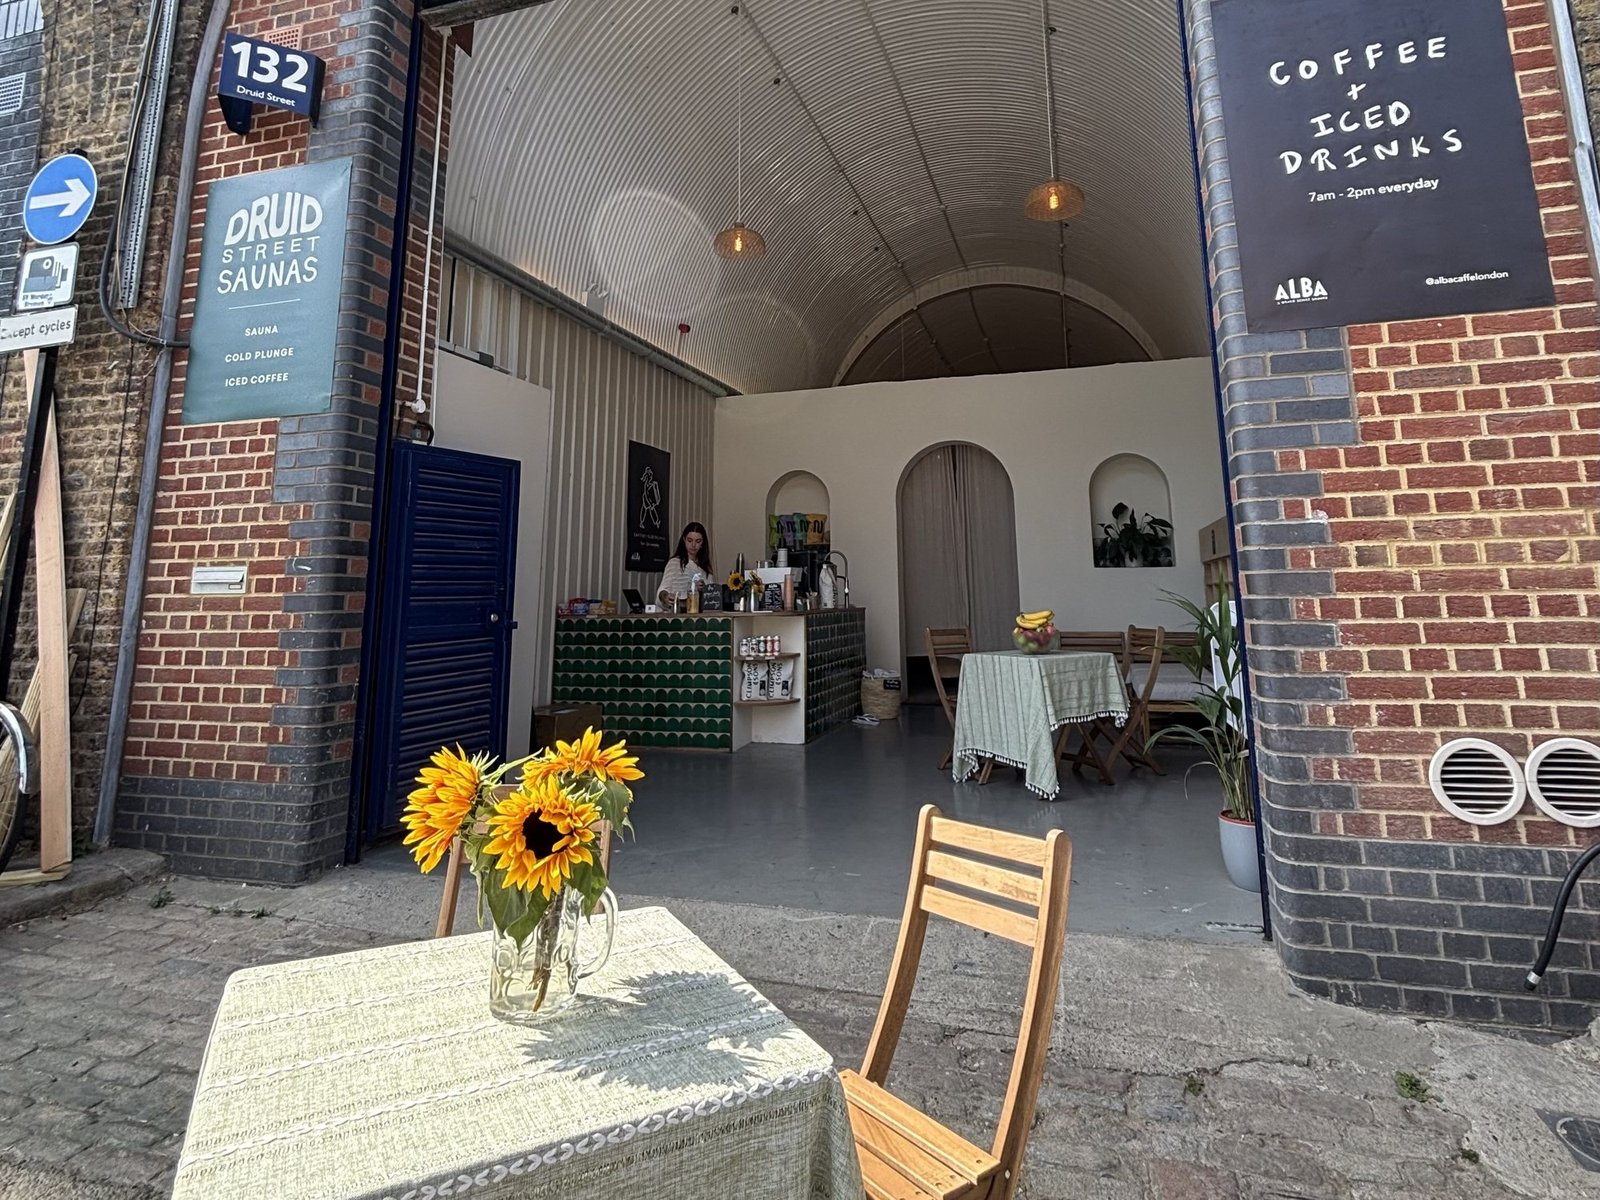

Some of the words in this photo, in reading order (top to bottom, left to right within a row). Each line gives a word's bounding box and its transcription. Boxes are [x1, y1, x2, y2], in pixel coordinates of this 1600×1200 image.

[230, 41, 308, 93] 132
[1269, 36, 1446, 86] COFFEE
[236, 85, 265, 99] Druid
[266, 92, 296, 107] Street
[1310, 101, 1410, 137] ICED
[1279, 128, 1463, 174] DRINKS
[1308, 191, 1336, 202] 7am
[1347, 187, 1375, 199] 2pm
[1378, 177, 1439, 194] everyday
[223, 192, 323, 246] DRUID
[222, 236, 320, 263] STREET
[217, 256, 318, 294] SAUNAS
[1425, 270, 1509, 286] @albacaffelondon
[1275, 276, 1328, 300] ALBA
[39, 319, 71, 335] cycles
[244, 325, 279, 337] SAUNA
[225, 352, 252, 363] COLD
[254, 347, 294, 360] PLUNGE
[224, 376, 249, 387] ICED
[250, 372, 289, 384] COFFEE
